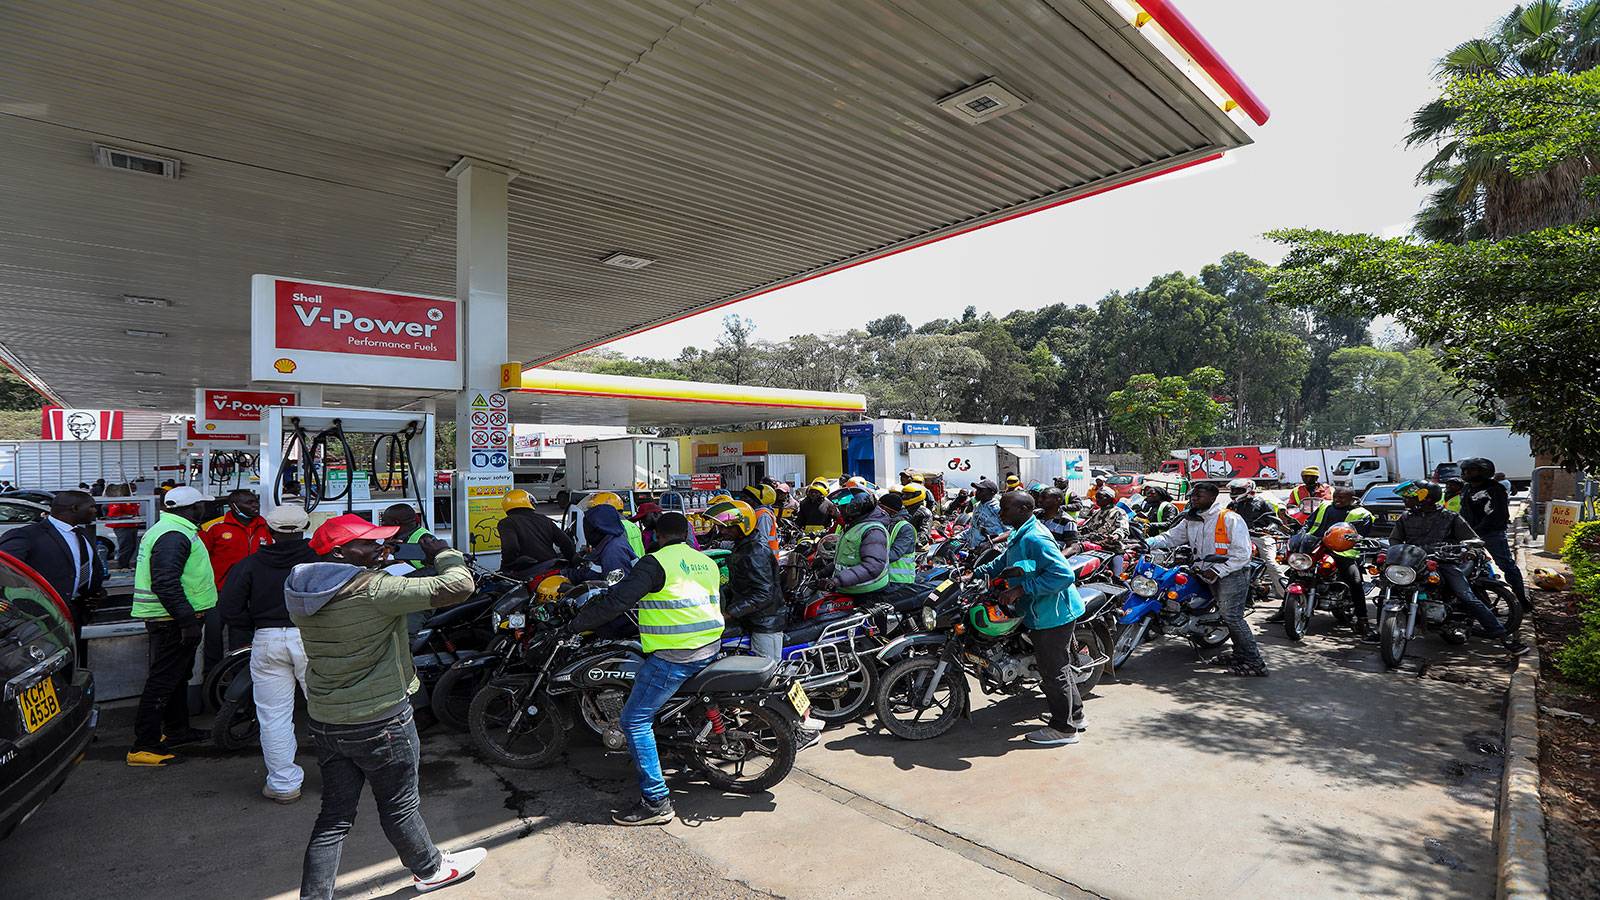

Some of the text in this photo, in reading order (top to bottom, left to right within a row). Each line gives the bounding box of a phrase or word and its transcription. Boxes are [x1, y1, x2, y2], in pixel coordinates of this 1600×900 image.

[292, 292, 322, 304] Shell
[293, 304, 439, 338] V-Power
[347, 336, 438, 353] Performance Fuels
[503, 368, 511, 383] 8
[722, 446, 738, 455] Shop
[1552, 507, 1564, 515] Air
[1552, 516, 1573, 525] Water
[23, 683, 46, 710] KCH
[30, 695, 57, 727] 453B
